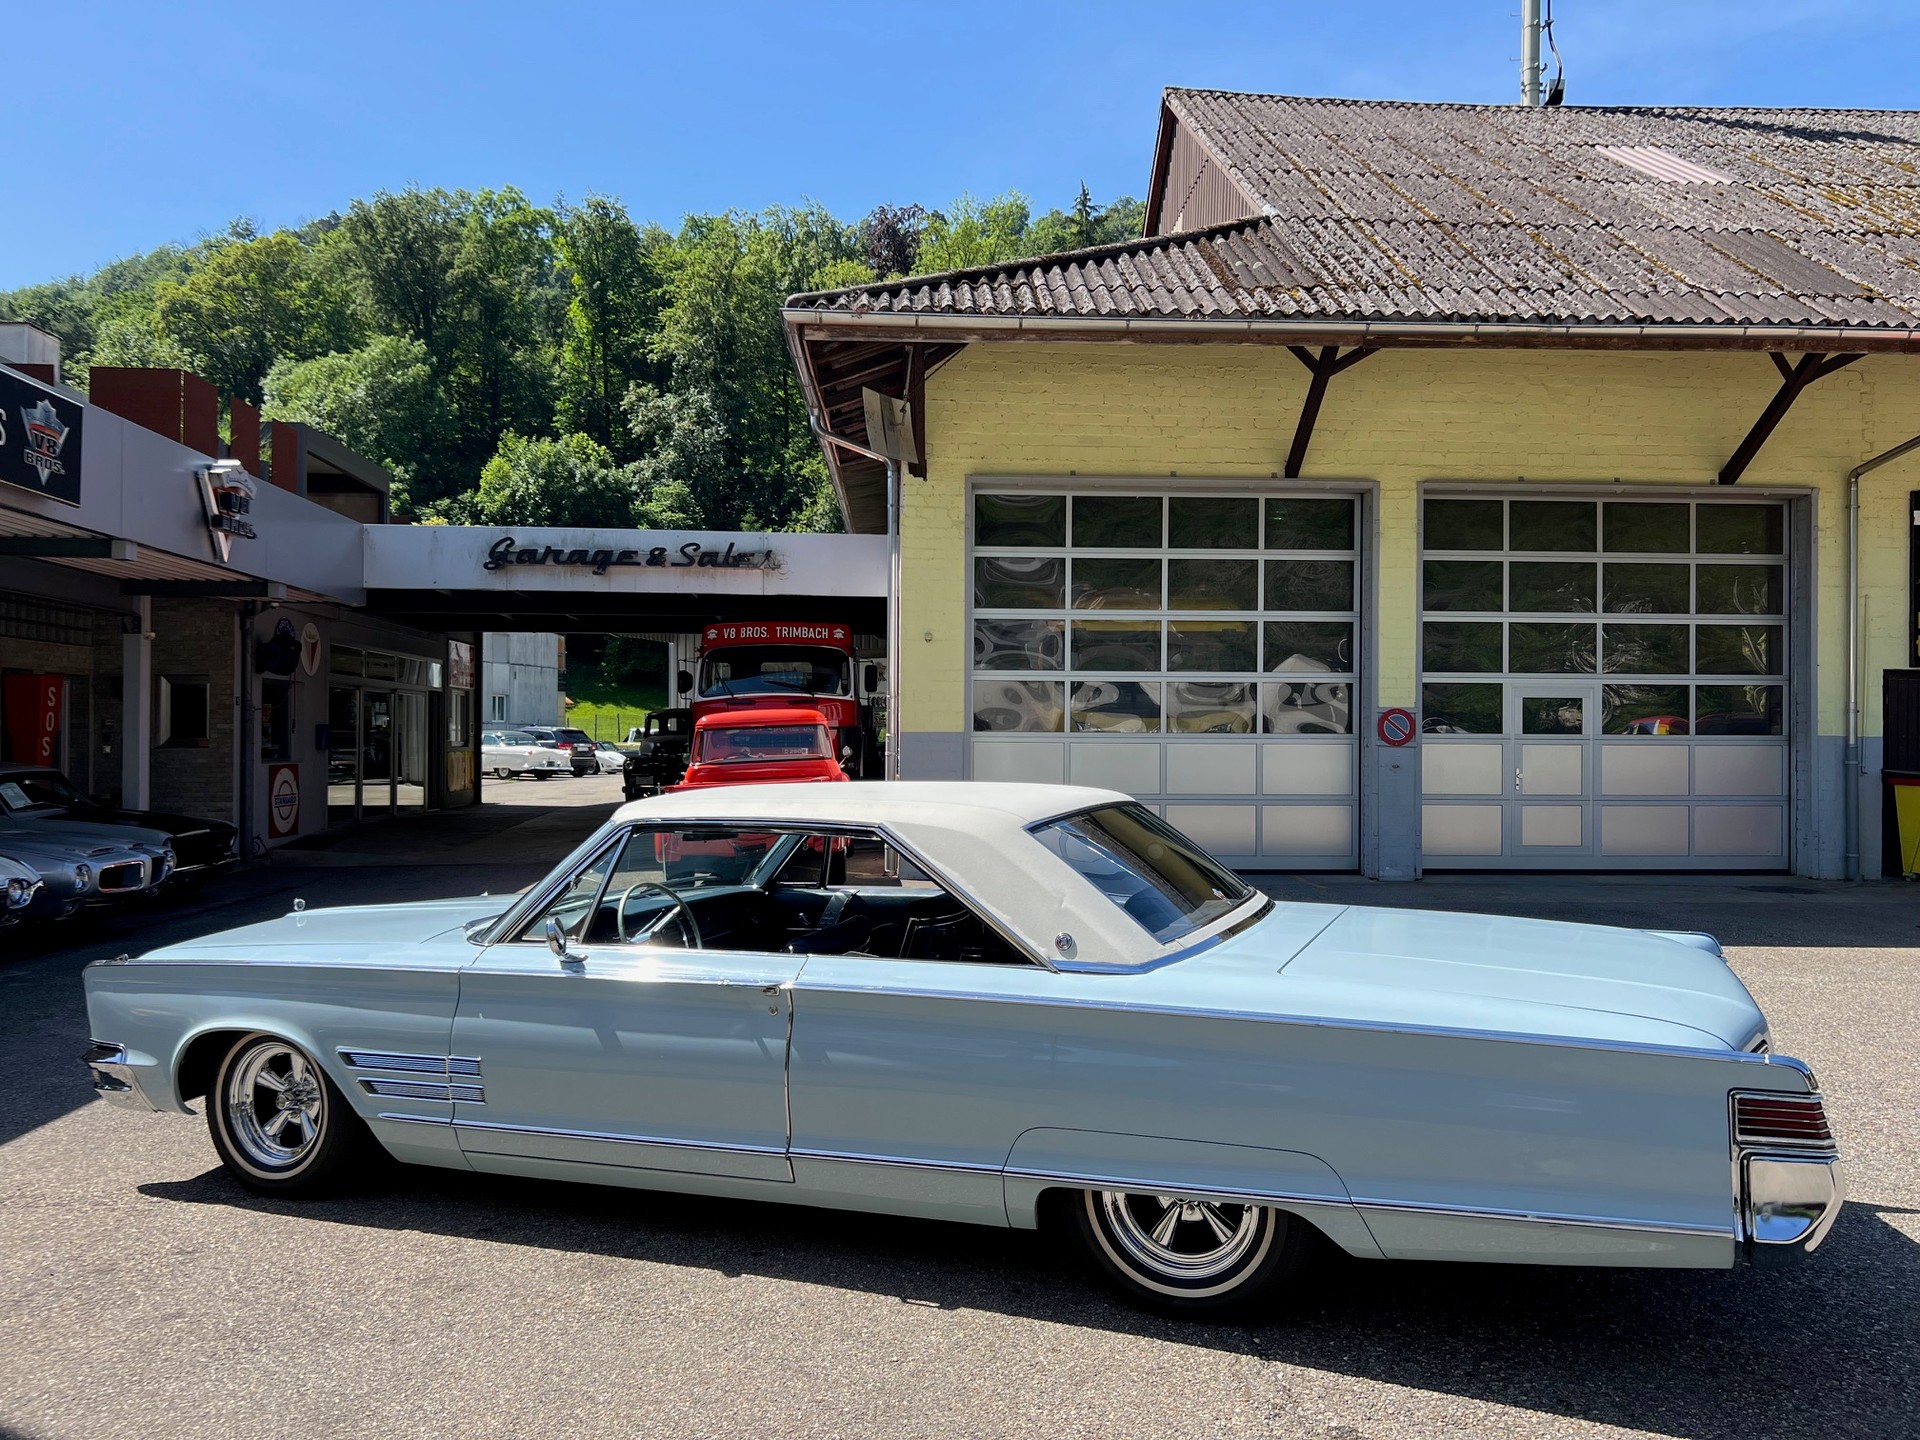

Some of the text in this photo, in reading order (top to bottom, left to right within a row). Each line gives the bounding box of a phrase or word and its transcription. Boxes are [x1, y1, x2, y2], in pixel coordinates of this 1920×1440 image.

[31, 431, 58, 455] V8
[483, 536, 641, 576] Garage
[645, 547, 667, 568] &
[723, 626, 829, 639] V8 BROS. TRIMBACH
[42, 686, 57, 757] SOS
[274, 795, 297, 806] STANDARD
